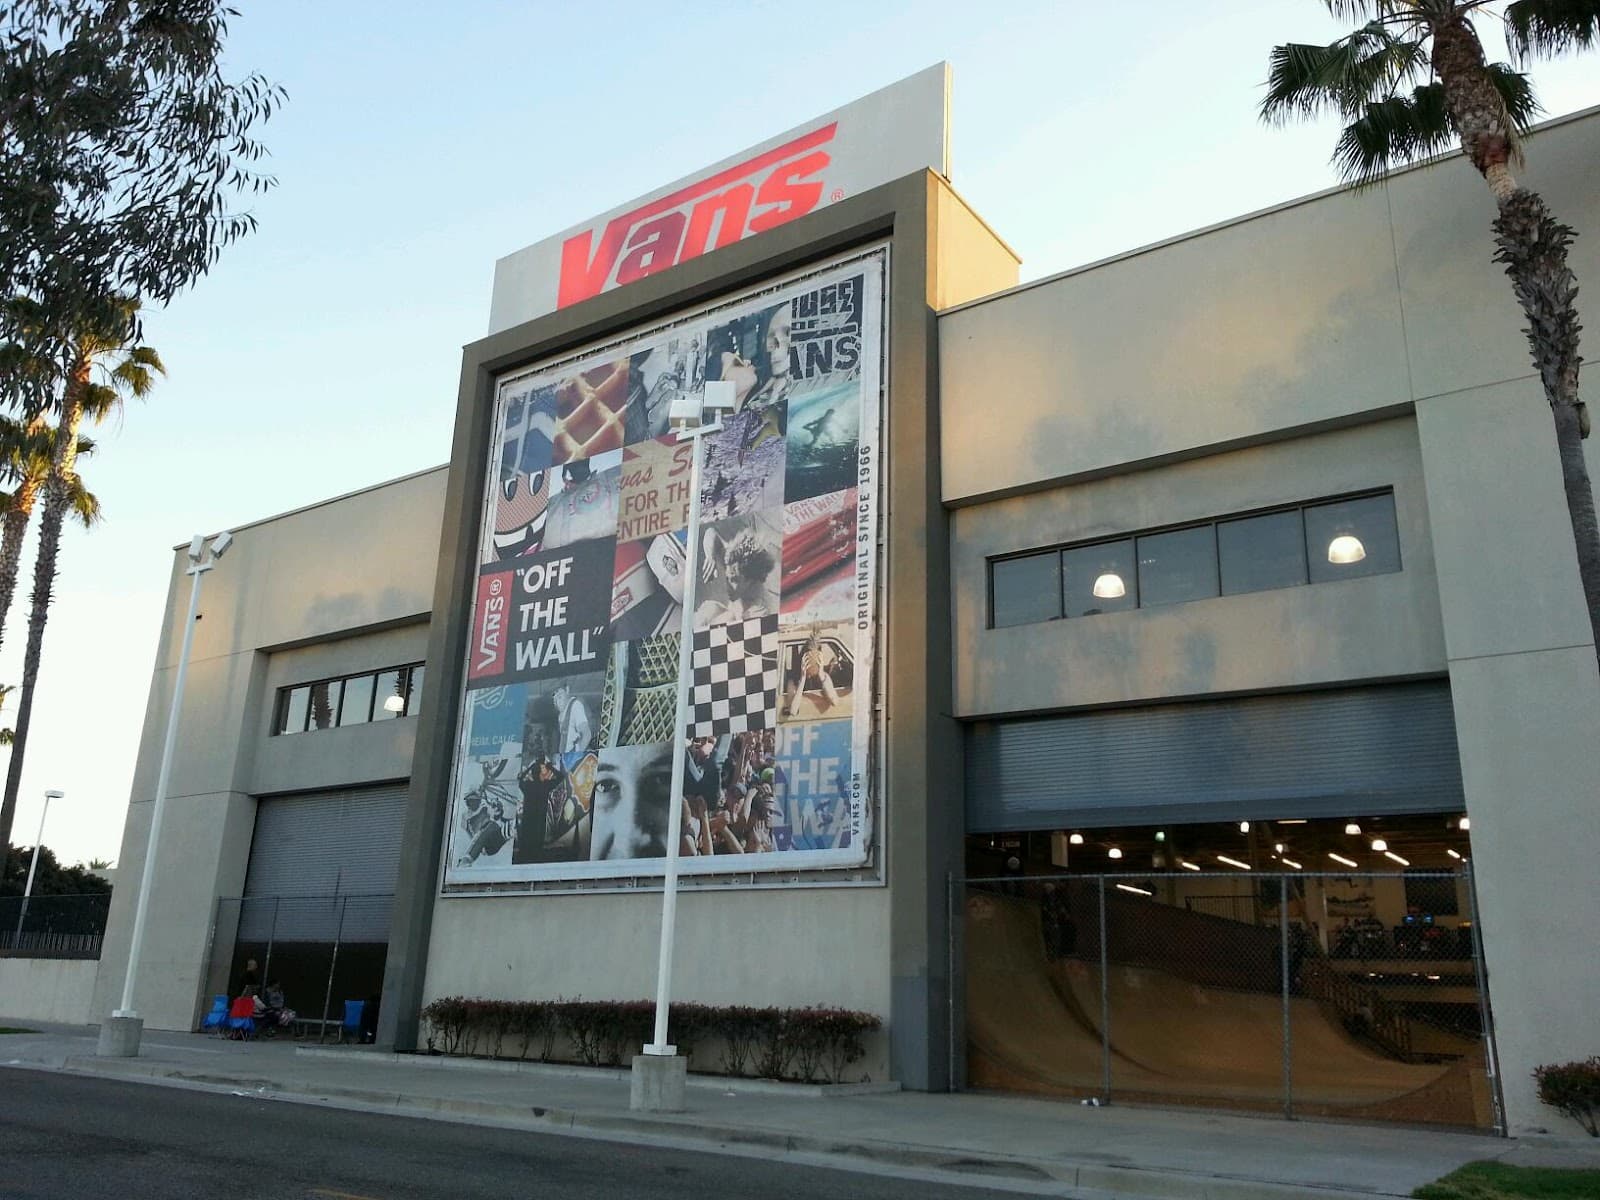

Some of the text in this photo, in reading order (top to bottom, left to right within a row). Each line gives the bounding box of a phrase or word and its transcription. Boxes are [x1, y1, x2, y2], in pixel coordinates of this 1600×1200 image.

[625, 489, 659, 516] FOR
[617, 508, 671, 540] NTIRE
[857, 445, 871, 630] ORIGINAL SINCE 1966
[520, 596, 569, 632] THE
[852, 773, 861, 836] VANS.COM
